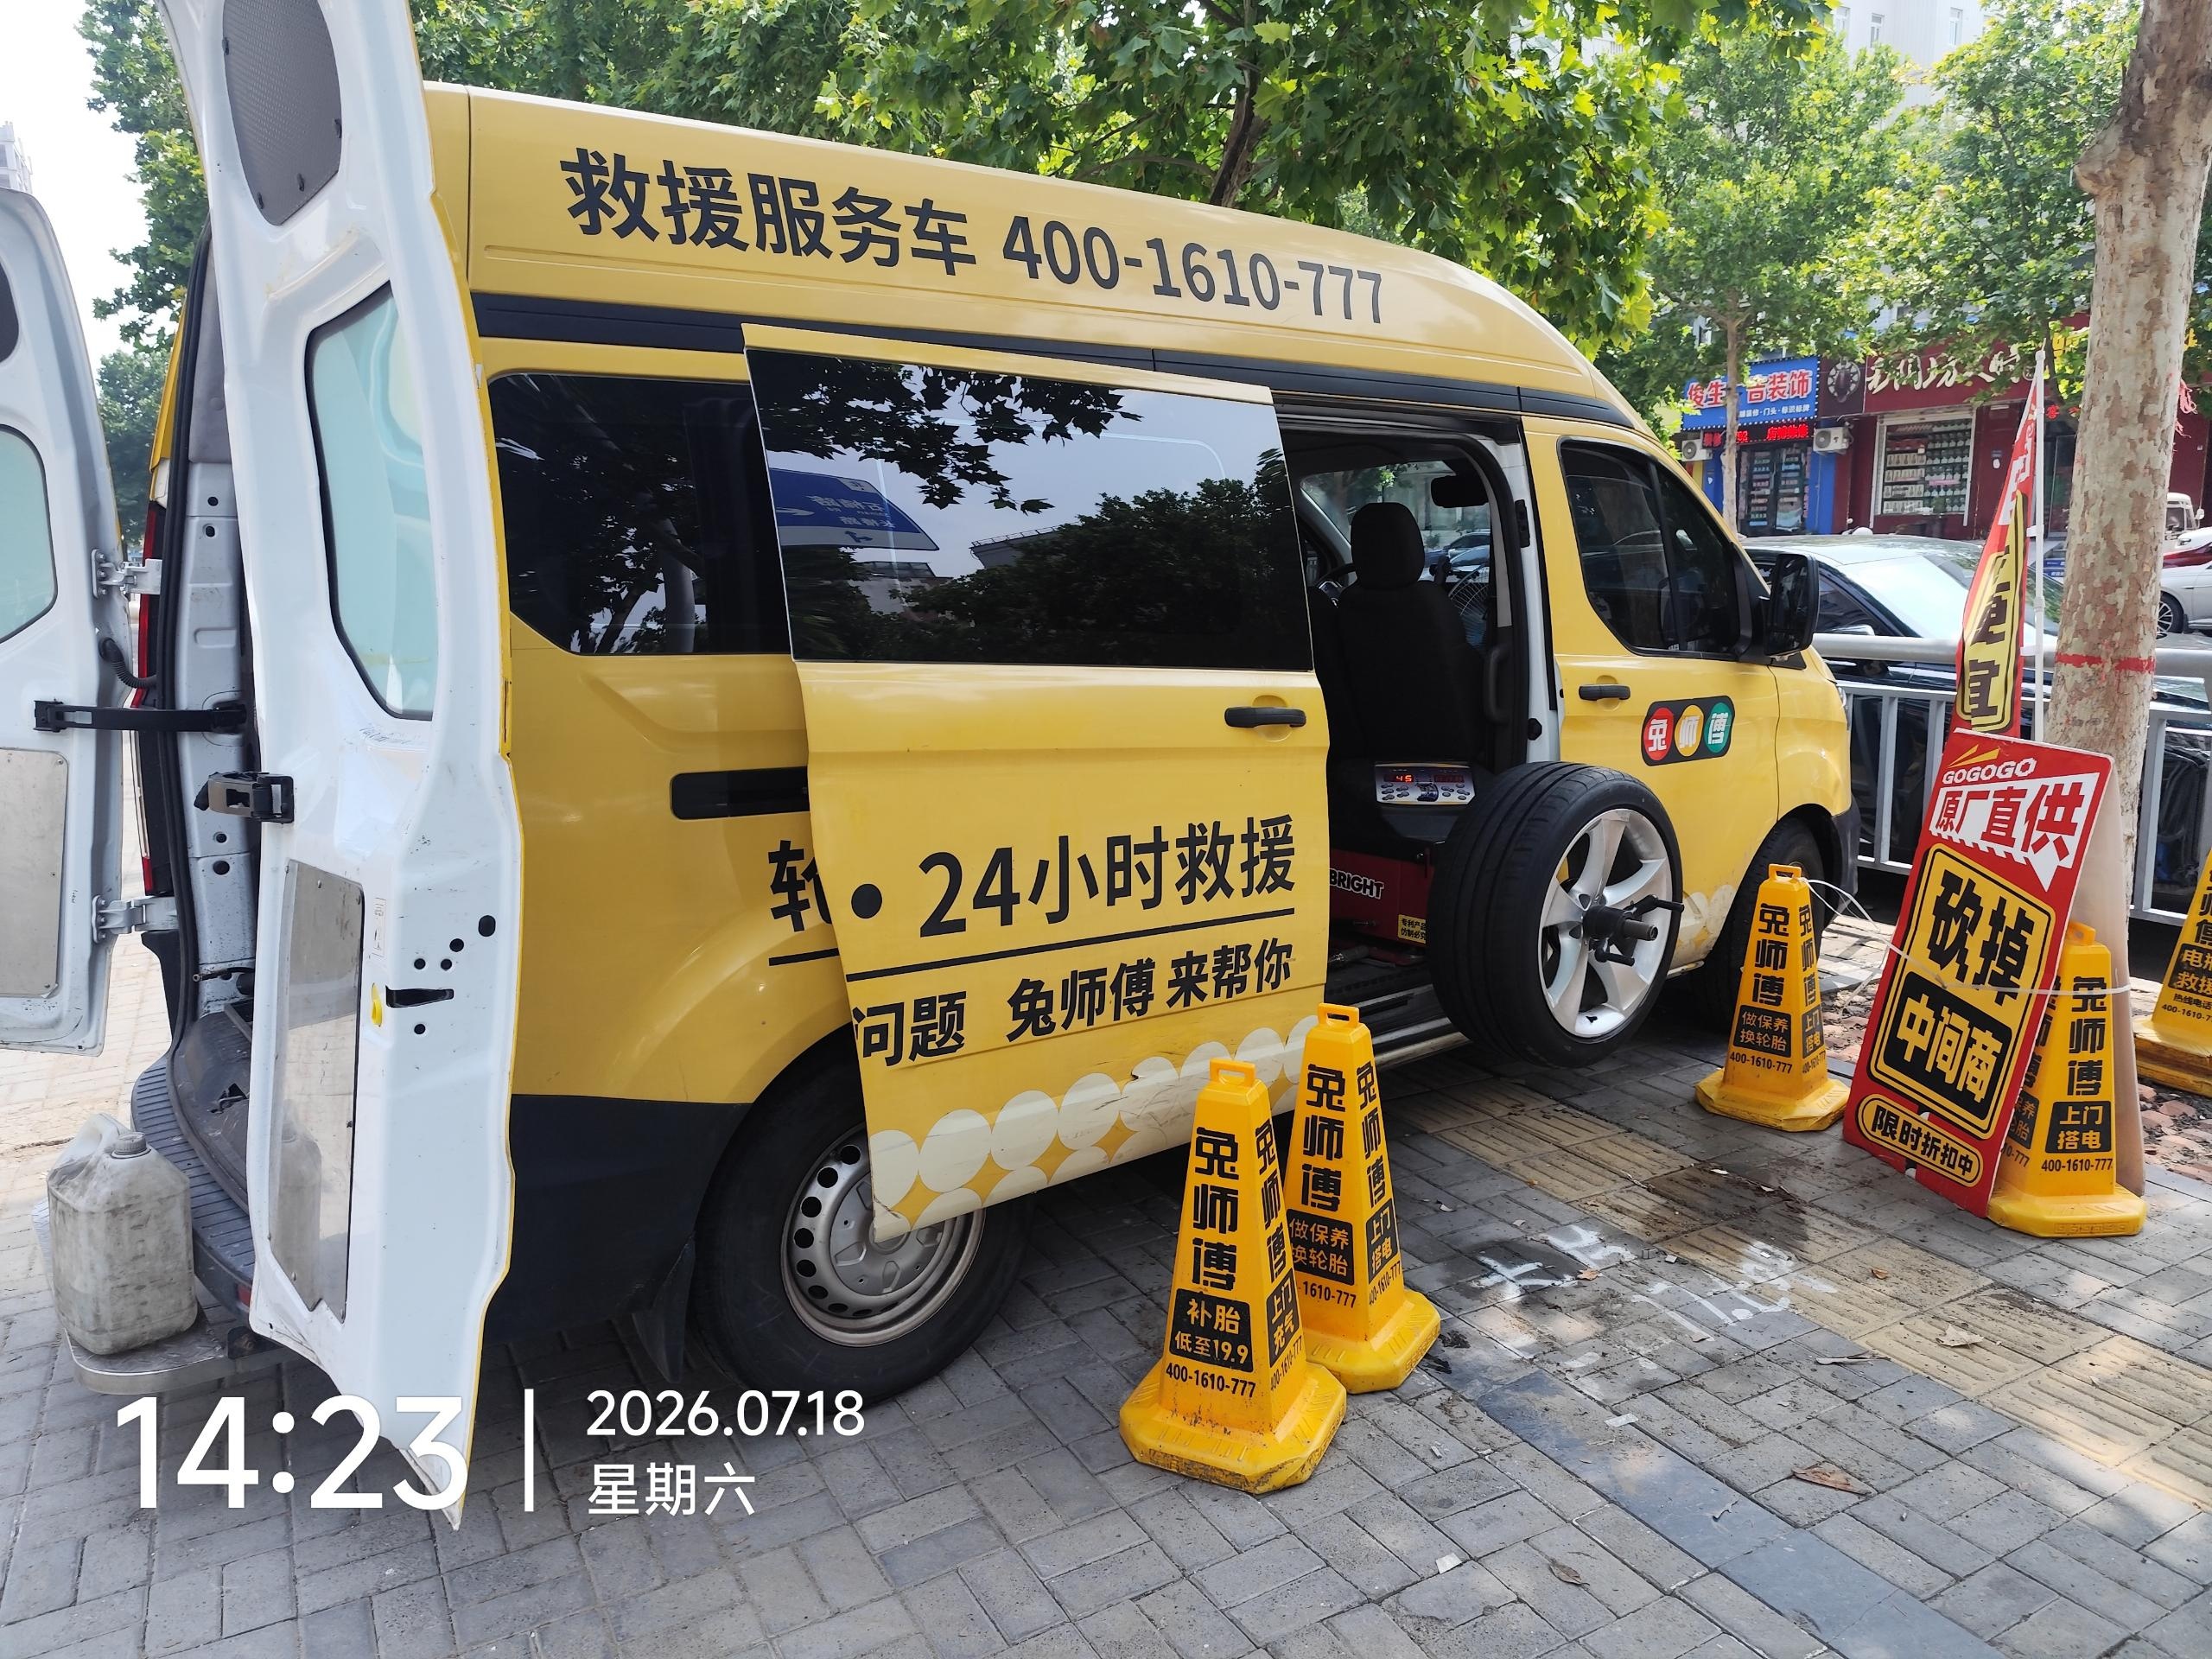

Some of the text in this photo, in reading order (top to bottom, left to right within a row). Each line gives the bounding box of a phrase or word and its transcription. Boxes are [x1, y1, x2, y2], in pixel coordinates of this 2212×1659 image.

[559, 148, 1382, 324] 救援服务车 400-1610-777
[1688, 370, 1812, 408] 俊生告装饰
[1942, 758, 2037, 784] GOGOGO
[1936, 782, 2085, 861] 原厂直供
[918, 814, 1295, 938] 24小时救援
[1330, 868, 1385, 899] BRIGHT
[1926, 869, 2035, 1007] 砍掉
[853, 938, 1294, 1067] 问题 兔师傅 来帮你
[1740, 1029, 1787, 1052] 换轮胎
[1742, 1011, 1789, 1033] 做保养
[1730, 1052, 1793, 1075] 400-1610-777
[1897, 995, 2002, 1103] 中间商
[2059, 1106, 2103, 1125] 上门
[1872, 1109, 1974, 1178] 限时折扣中
[2057, 1130, 2102, 1151] 搭电
[2041, 1158, 2113, 1173] 400-1610-777
[1289, 1217, 1349, 1250] 做保养
[1371, 1206, 1391, 1244] 上门
[1292, 1243, 1348, 1277] 换轮胎
[1271, 1277, 1293, 1324] 上门
[1369, 1260, 1401, 1306] 400-1610-777
[1186, 1298, 1241, 1335] 补胎
[1273, 1309, 1295, 1356] 充气
[1174, 1331, 1249, 1364] 低至19.9
[1270, 1335, 1303, 1391] 400-1610-777
[1166, 1363, 1256, 1398] 400-1610-777
